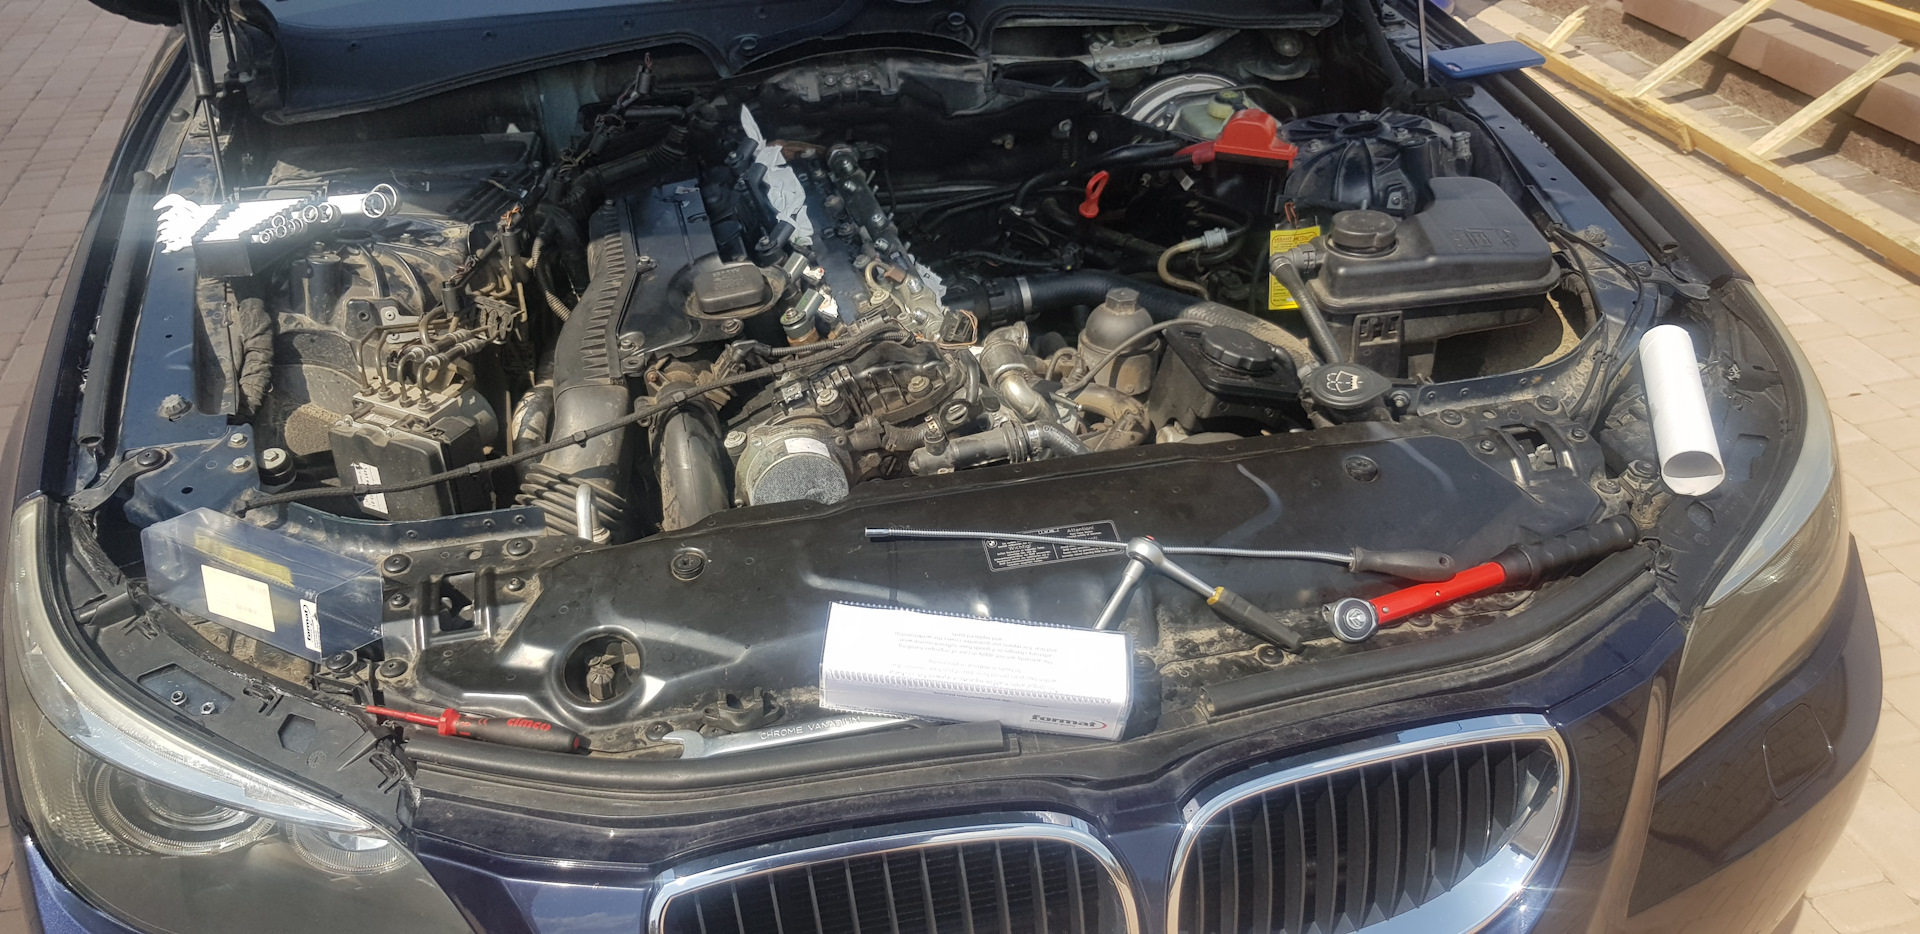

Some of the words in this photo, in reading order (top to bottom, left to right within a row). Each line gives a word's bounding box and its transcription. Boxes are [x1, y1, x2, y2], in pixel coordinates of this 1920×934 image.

[760, 725, 803, 740] CHROME
[807, 715, 861, 731] VANADIUM
[1031, 714, 1096, 727] format
